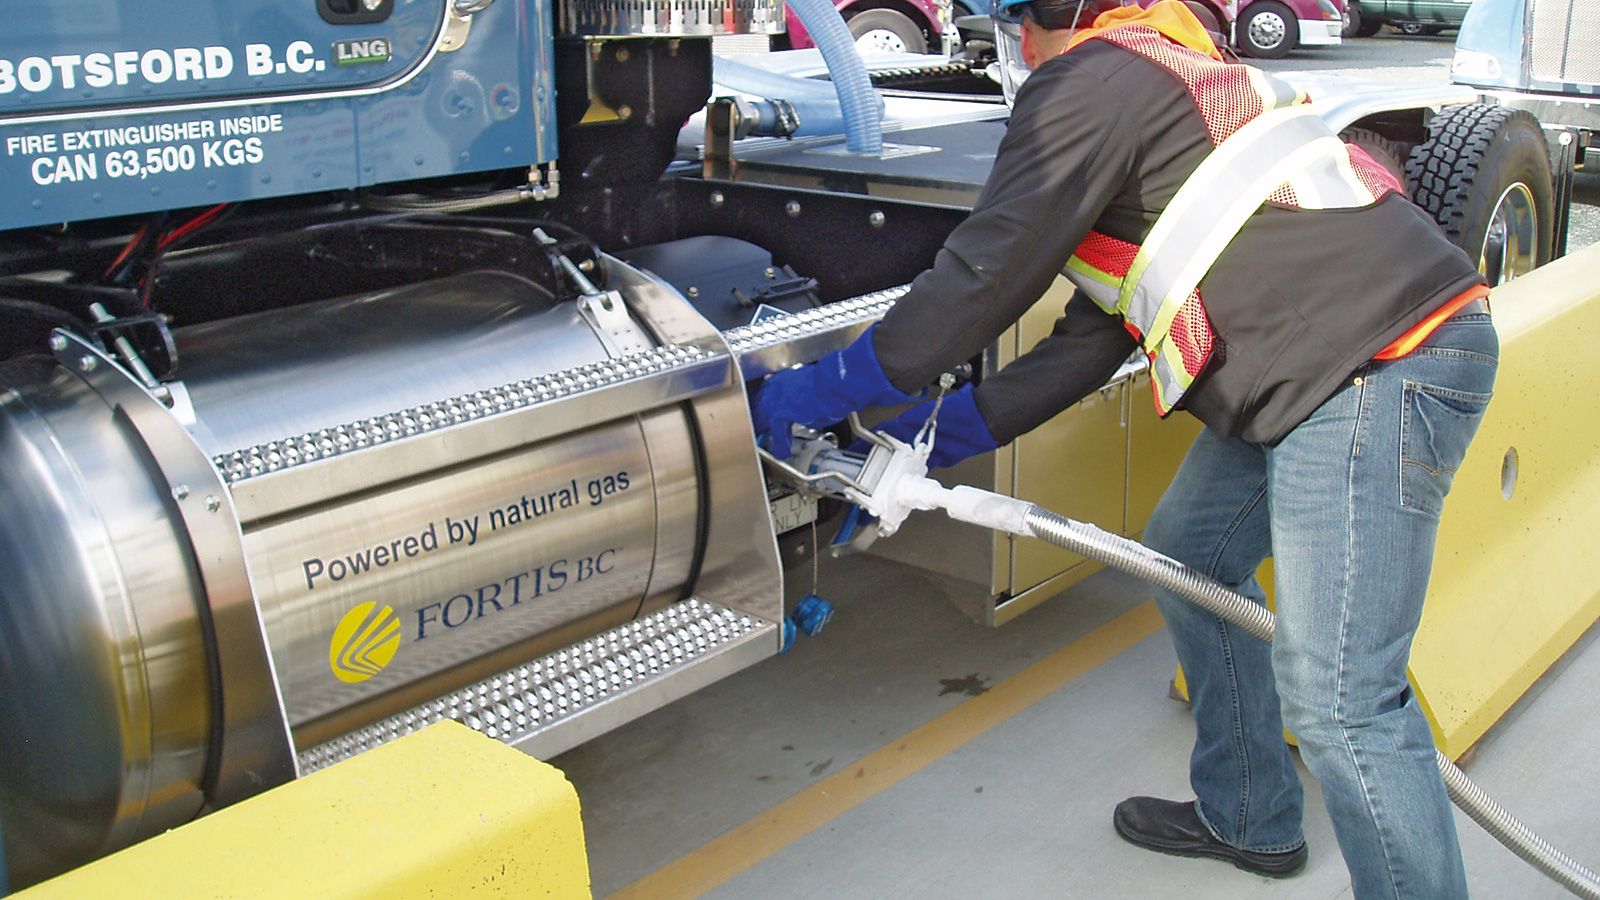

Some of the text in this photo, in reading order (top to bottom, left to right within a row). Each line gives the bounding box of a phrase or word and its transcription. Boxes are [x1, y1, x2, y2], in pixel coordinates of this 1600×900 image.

[246, 41, 326, 77] B.C.
[337, 40, 387, 60] LNG
[7, 114, 283, 156] FIRE EXTINGUISHER INSIDE
[31, 137, 264, 186] CAN 63,500 KGS
[303, 470, 631, 590] Powered by natural gas
[413, 549, 616, 642] FORTIS BC
